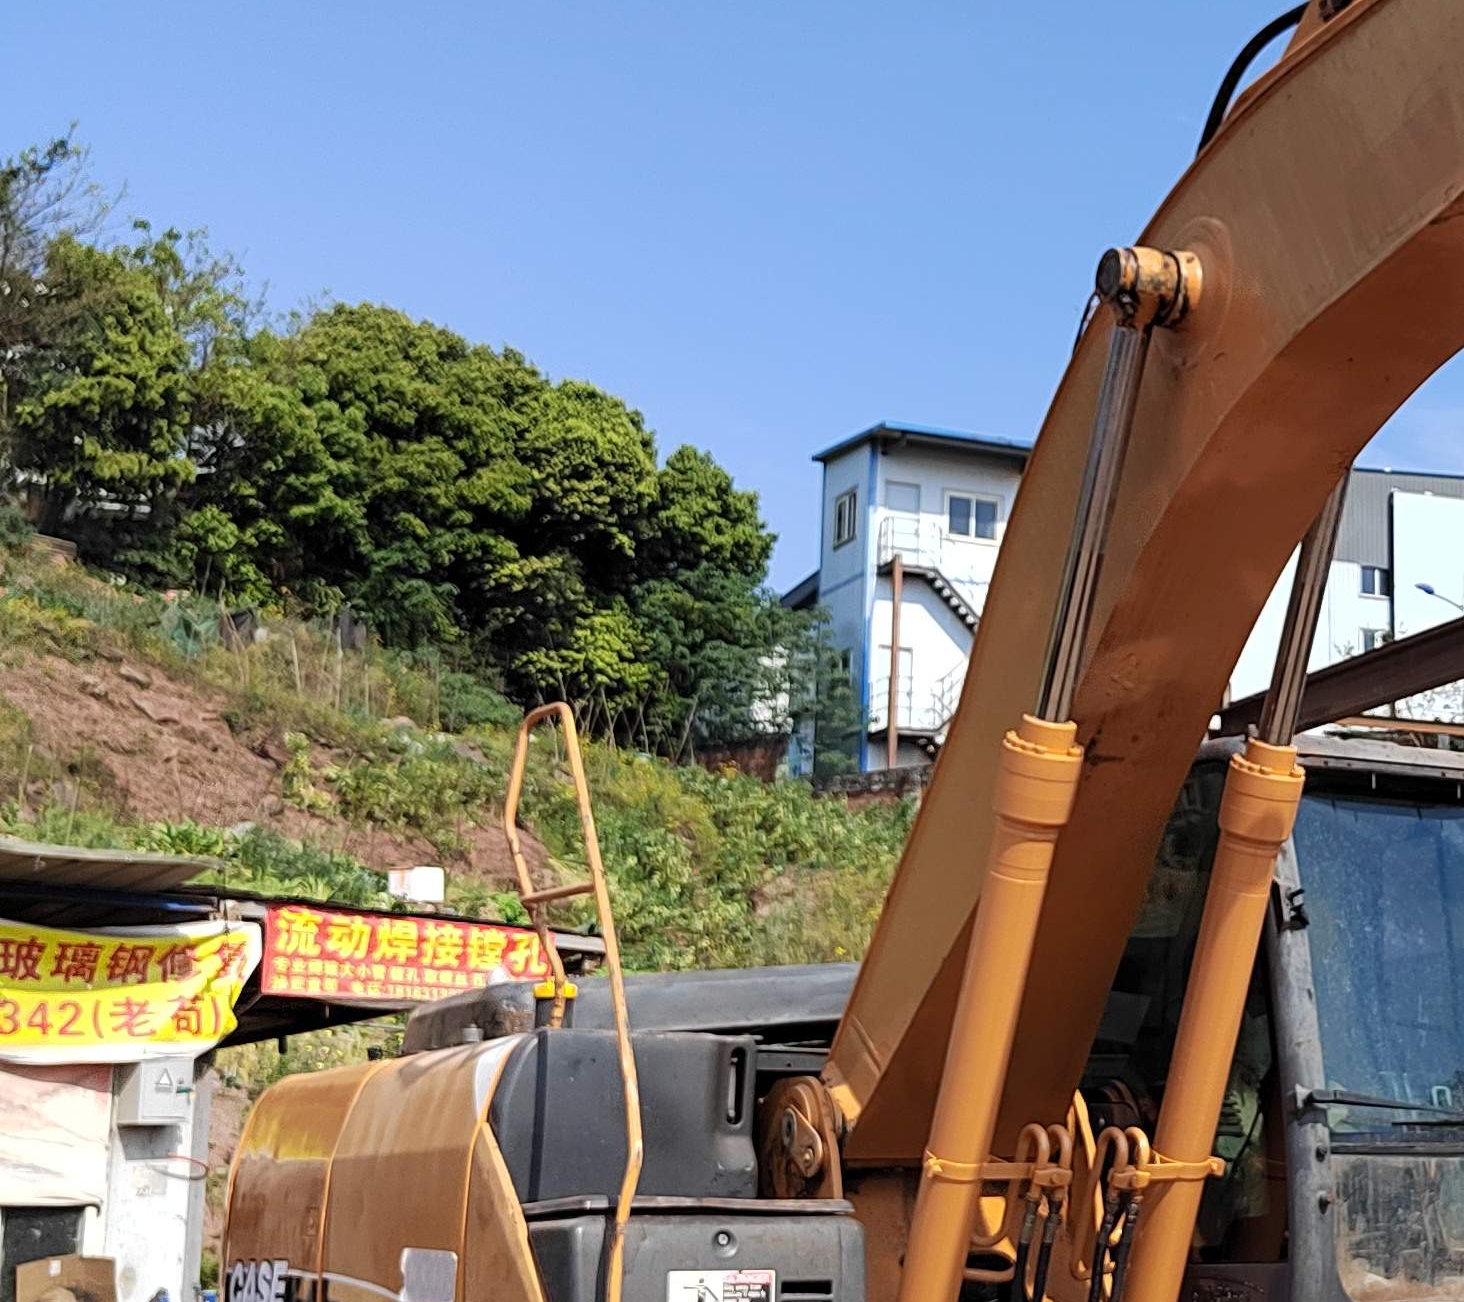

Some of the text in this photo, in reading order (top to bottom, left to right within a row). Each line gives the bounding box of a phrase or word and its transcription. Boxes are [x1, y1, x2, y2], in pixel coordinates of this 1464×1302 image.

[275, 907, 548, 976] 流动焊接镗孔
